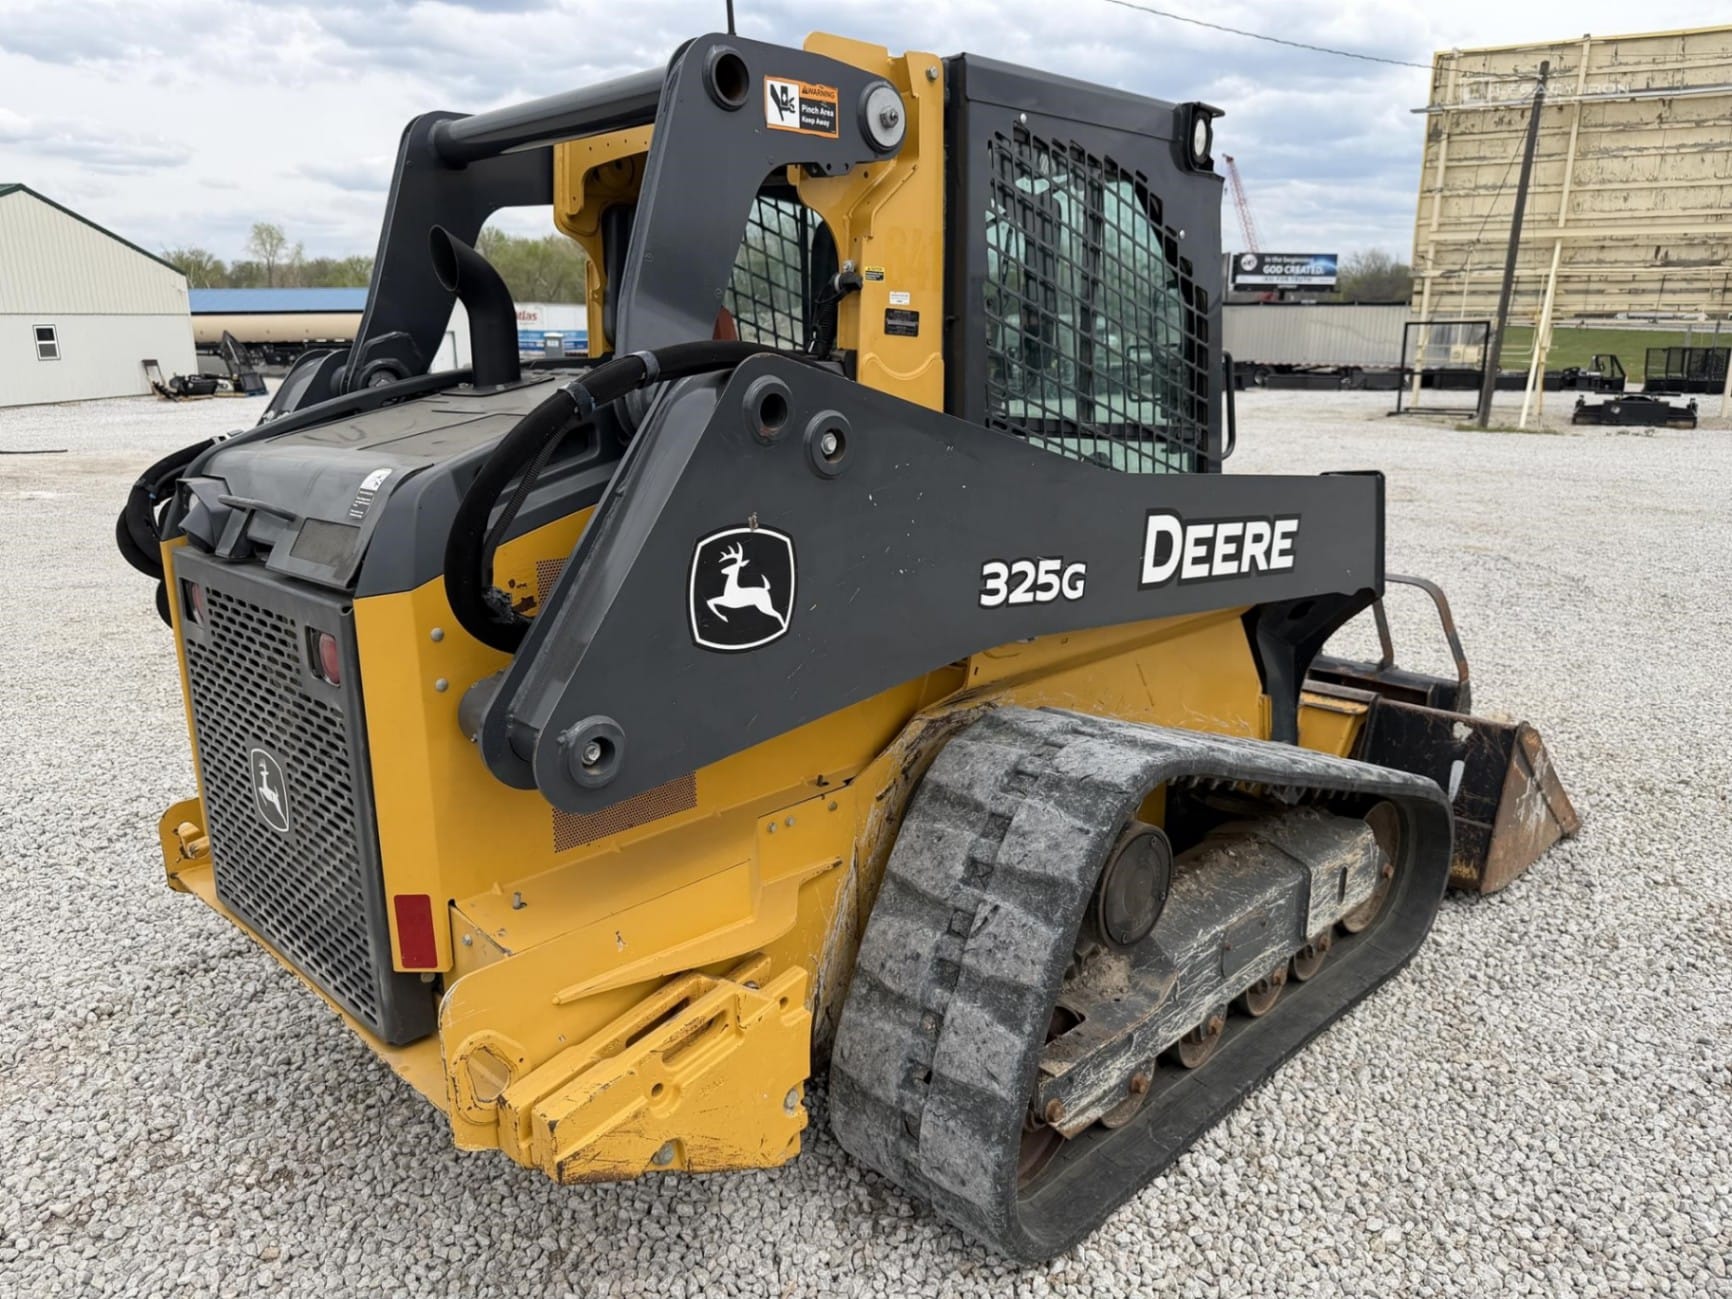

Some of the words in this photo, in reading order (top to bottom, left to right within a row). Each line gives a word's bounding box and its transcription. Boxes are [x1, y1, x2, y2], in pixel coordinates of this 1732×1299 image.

[808, 87, 835, 99] WARNING
[801, 103, 819, 115] Pinch
[820, 107, 834, 117] Area
[801, 115, 815, 125] Keep
[816, 117, 830, 128] Away
[1262, 264, 1283, 274] GOD
[1141, 513, 1299, 584] DEERE
[979, 558, 1087, 607] 325G
